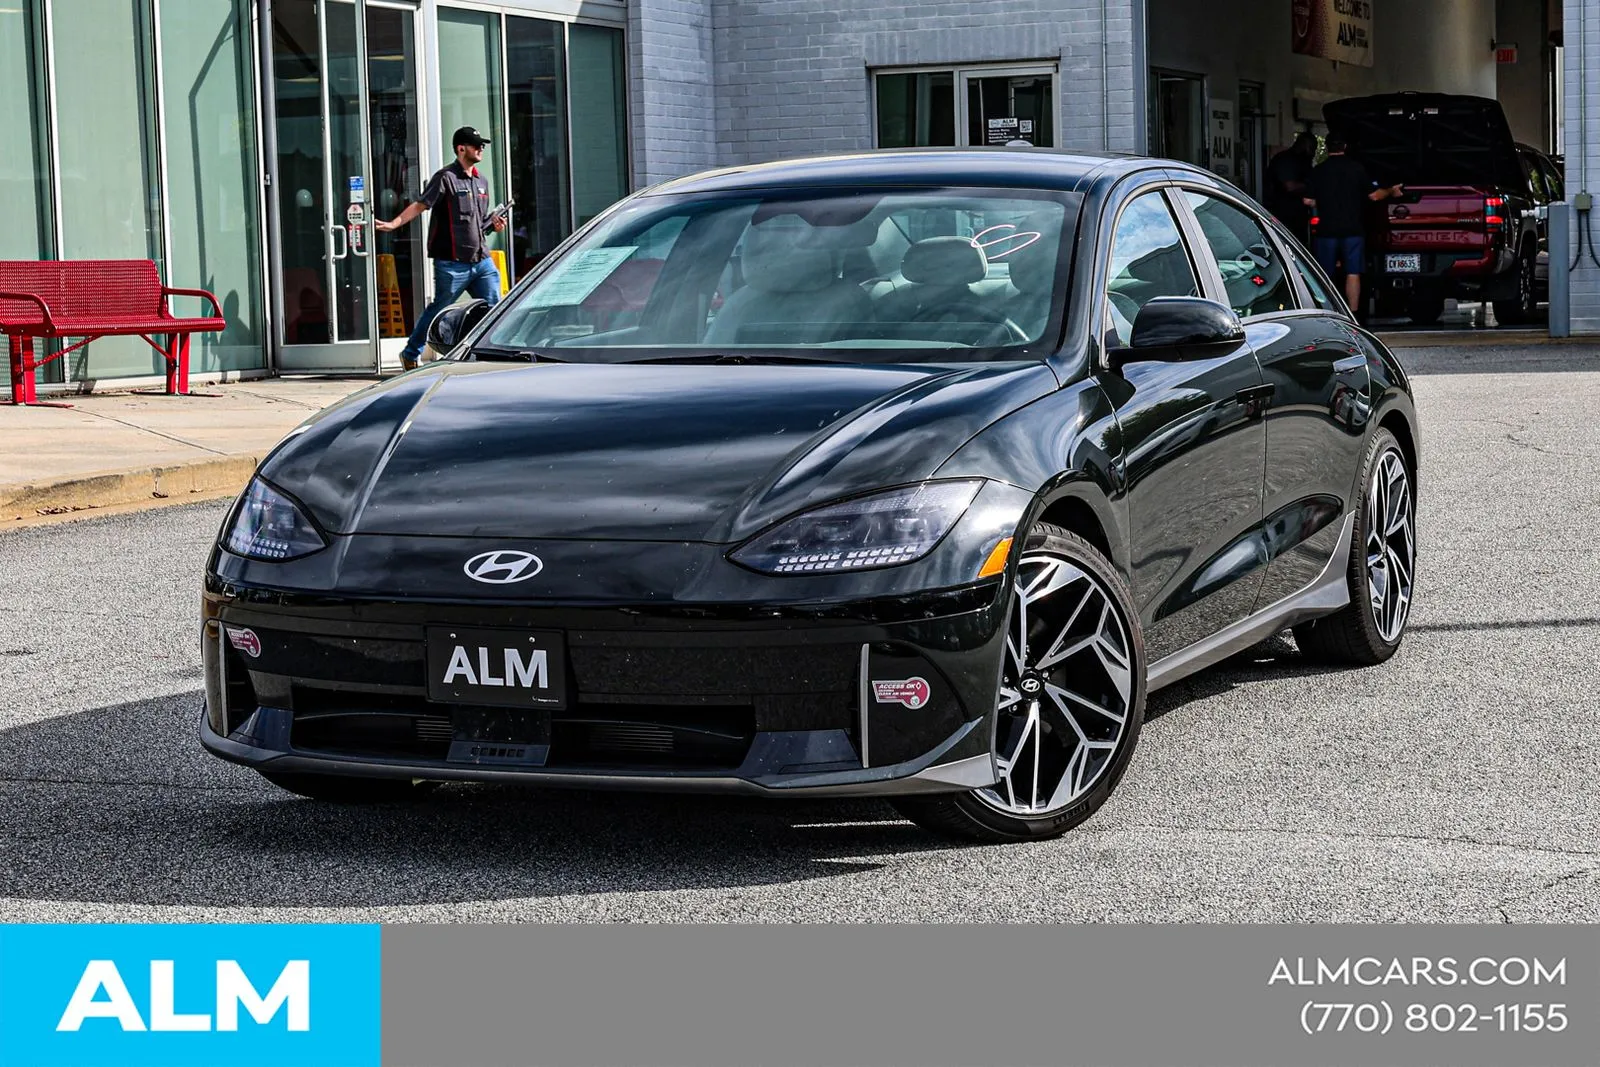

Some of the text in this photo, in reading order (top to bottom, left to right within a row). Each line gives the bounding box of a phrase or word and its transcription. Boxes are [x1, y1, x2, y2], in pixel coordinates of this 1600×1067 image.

[1337, 21, 1356, 48] ALM
[1213, 136, 1231, 159] ALM
[443, 646, 548, 688] ALM
